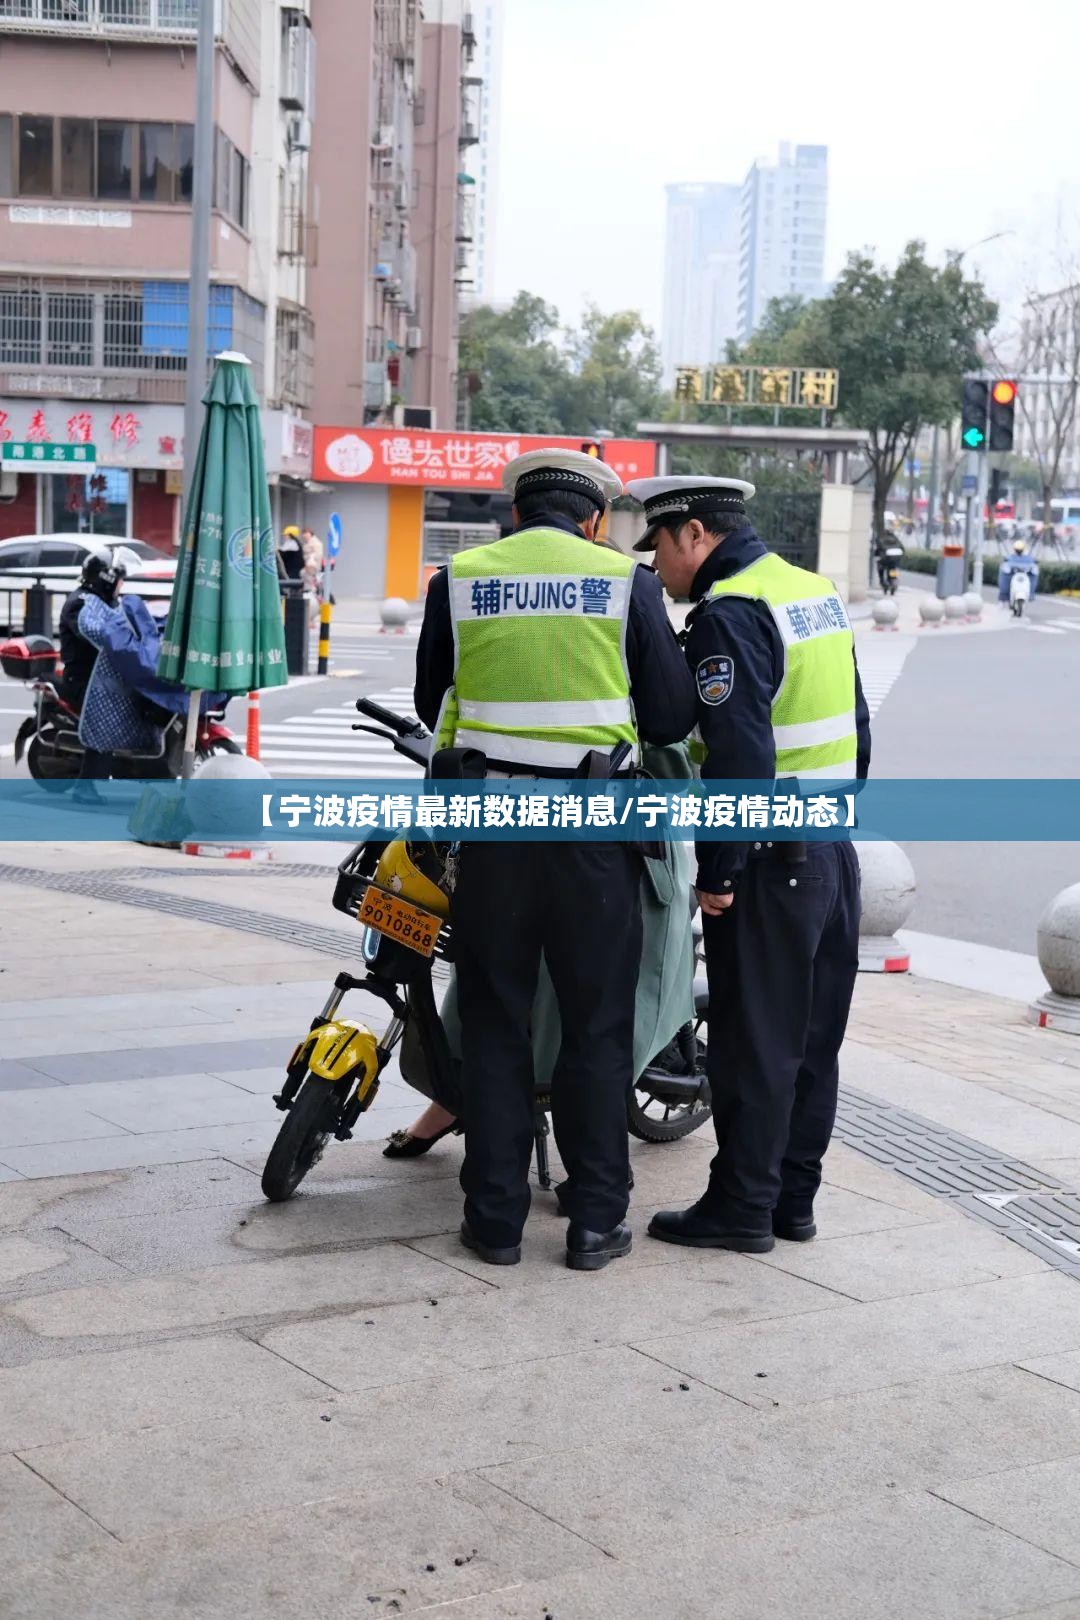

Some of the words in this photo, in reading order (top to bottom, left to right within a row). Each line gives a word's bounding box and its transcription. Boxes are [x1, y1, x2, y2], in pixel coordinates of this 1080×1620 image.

[380, 437, 507, 469] 馒头世家
[423, 468, 447, 479] TOU
[364, 905, 432, 947] 9010868
